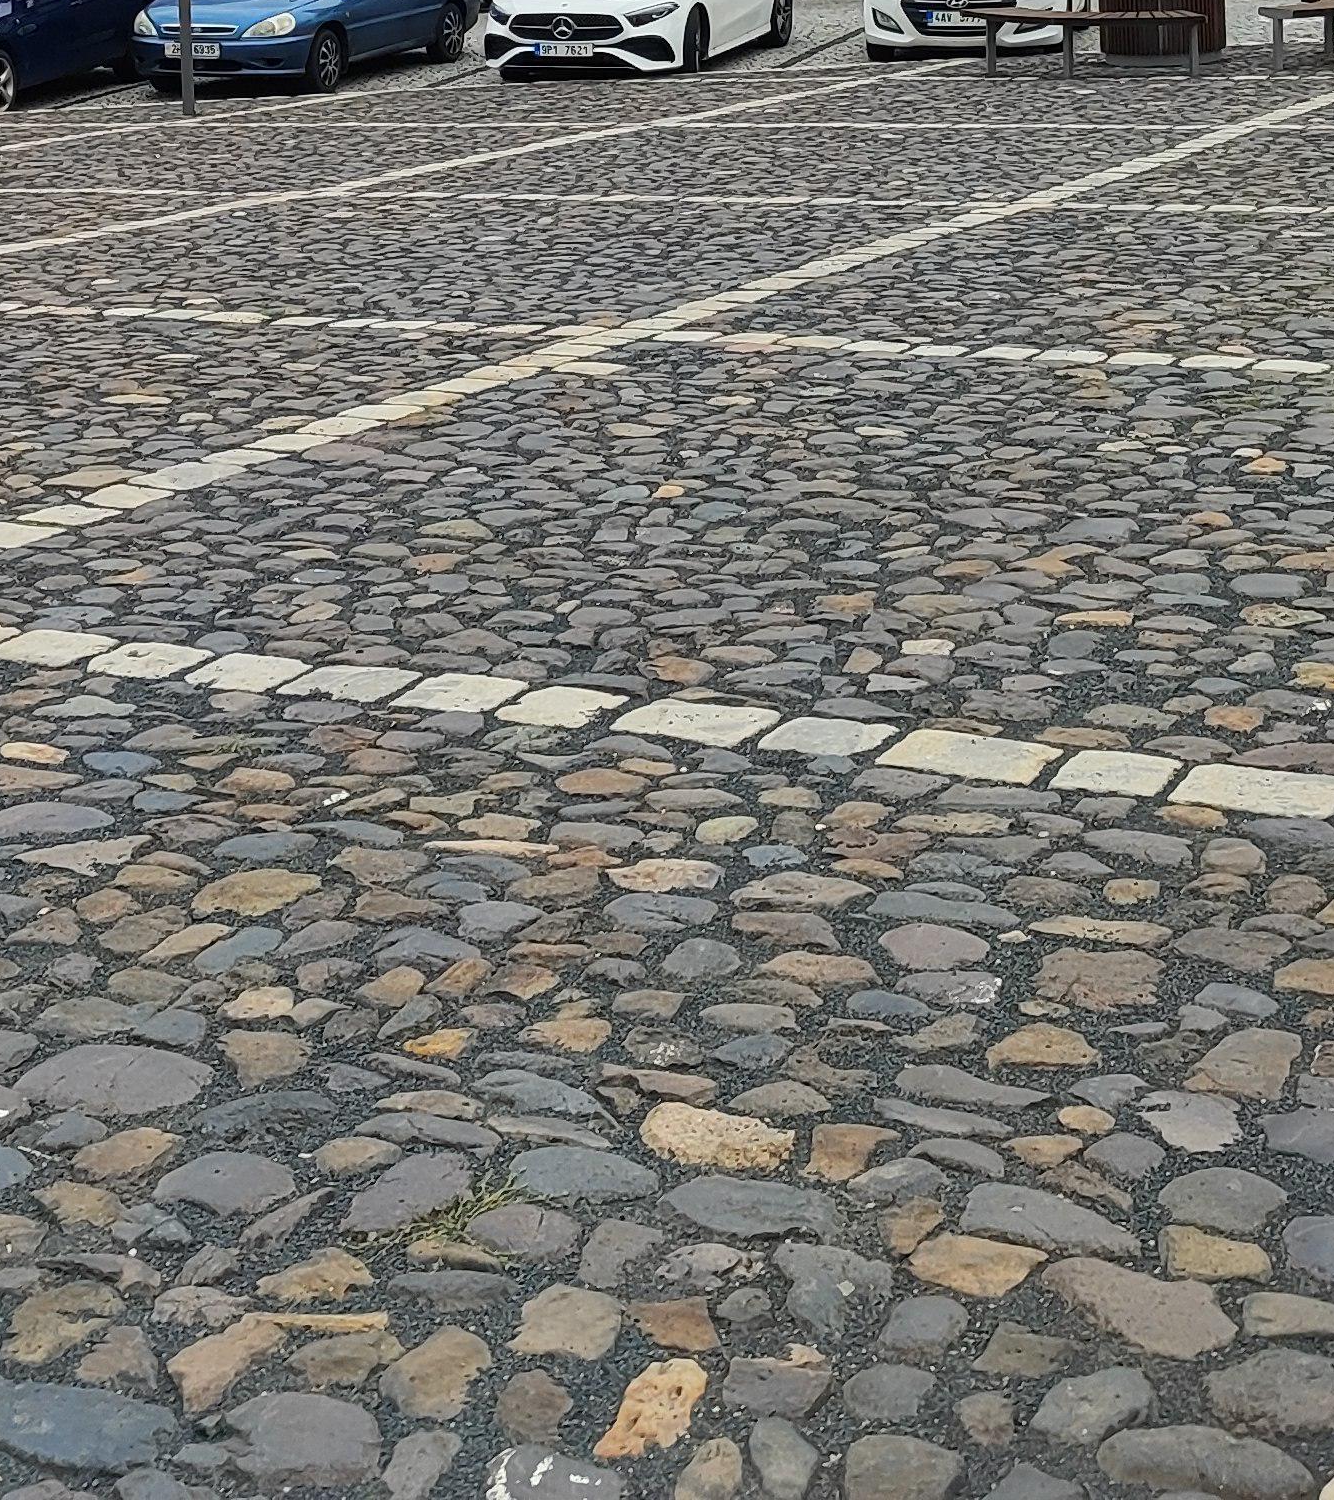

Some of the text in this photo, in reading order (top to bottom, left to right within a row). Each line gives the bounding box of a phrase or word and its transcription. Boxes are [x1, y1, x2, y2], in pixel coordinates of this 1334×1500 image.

[934, 12, 953, 23] 4AV
[541, 44, 589, 56] 9P1 7621
